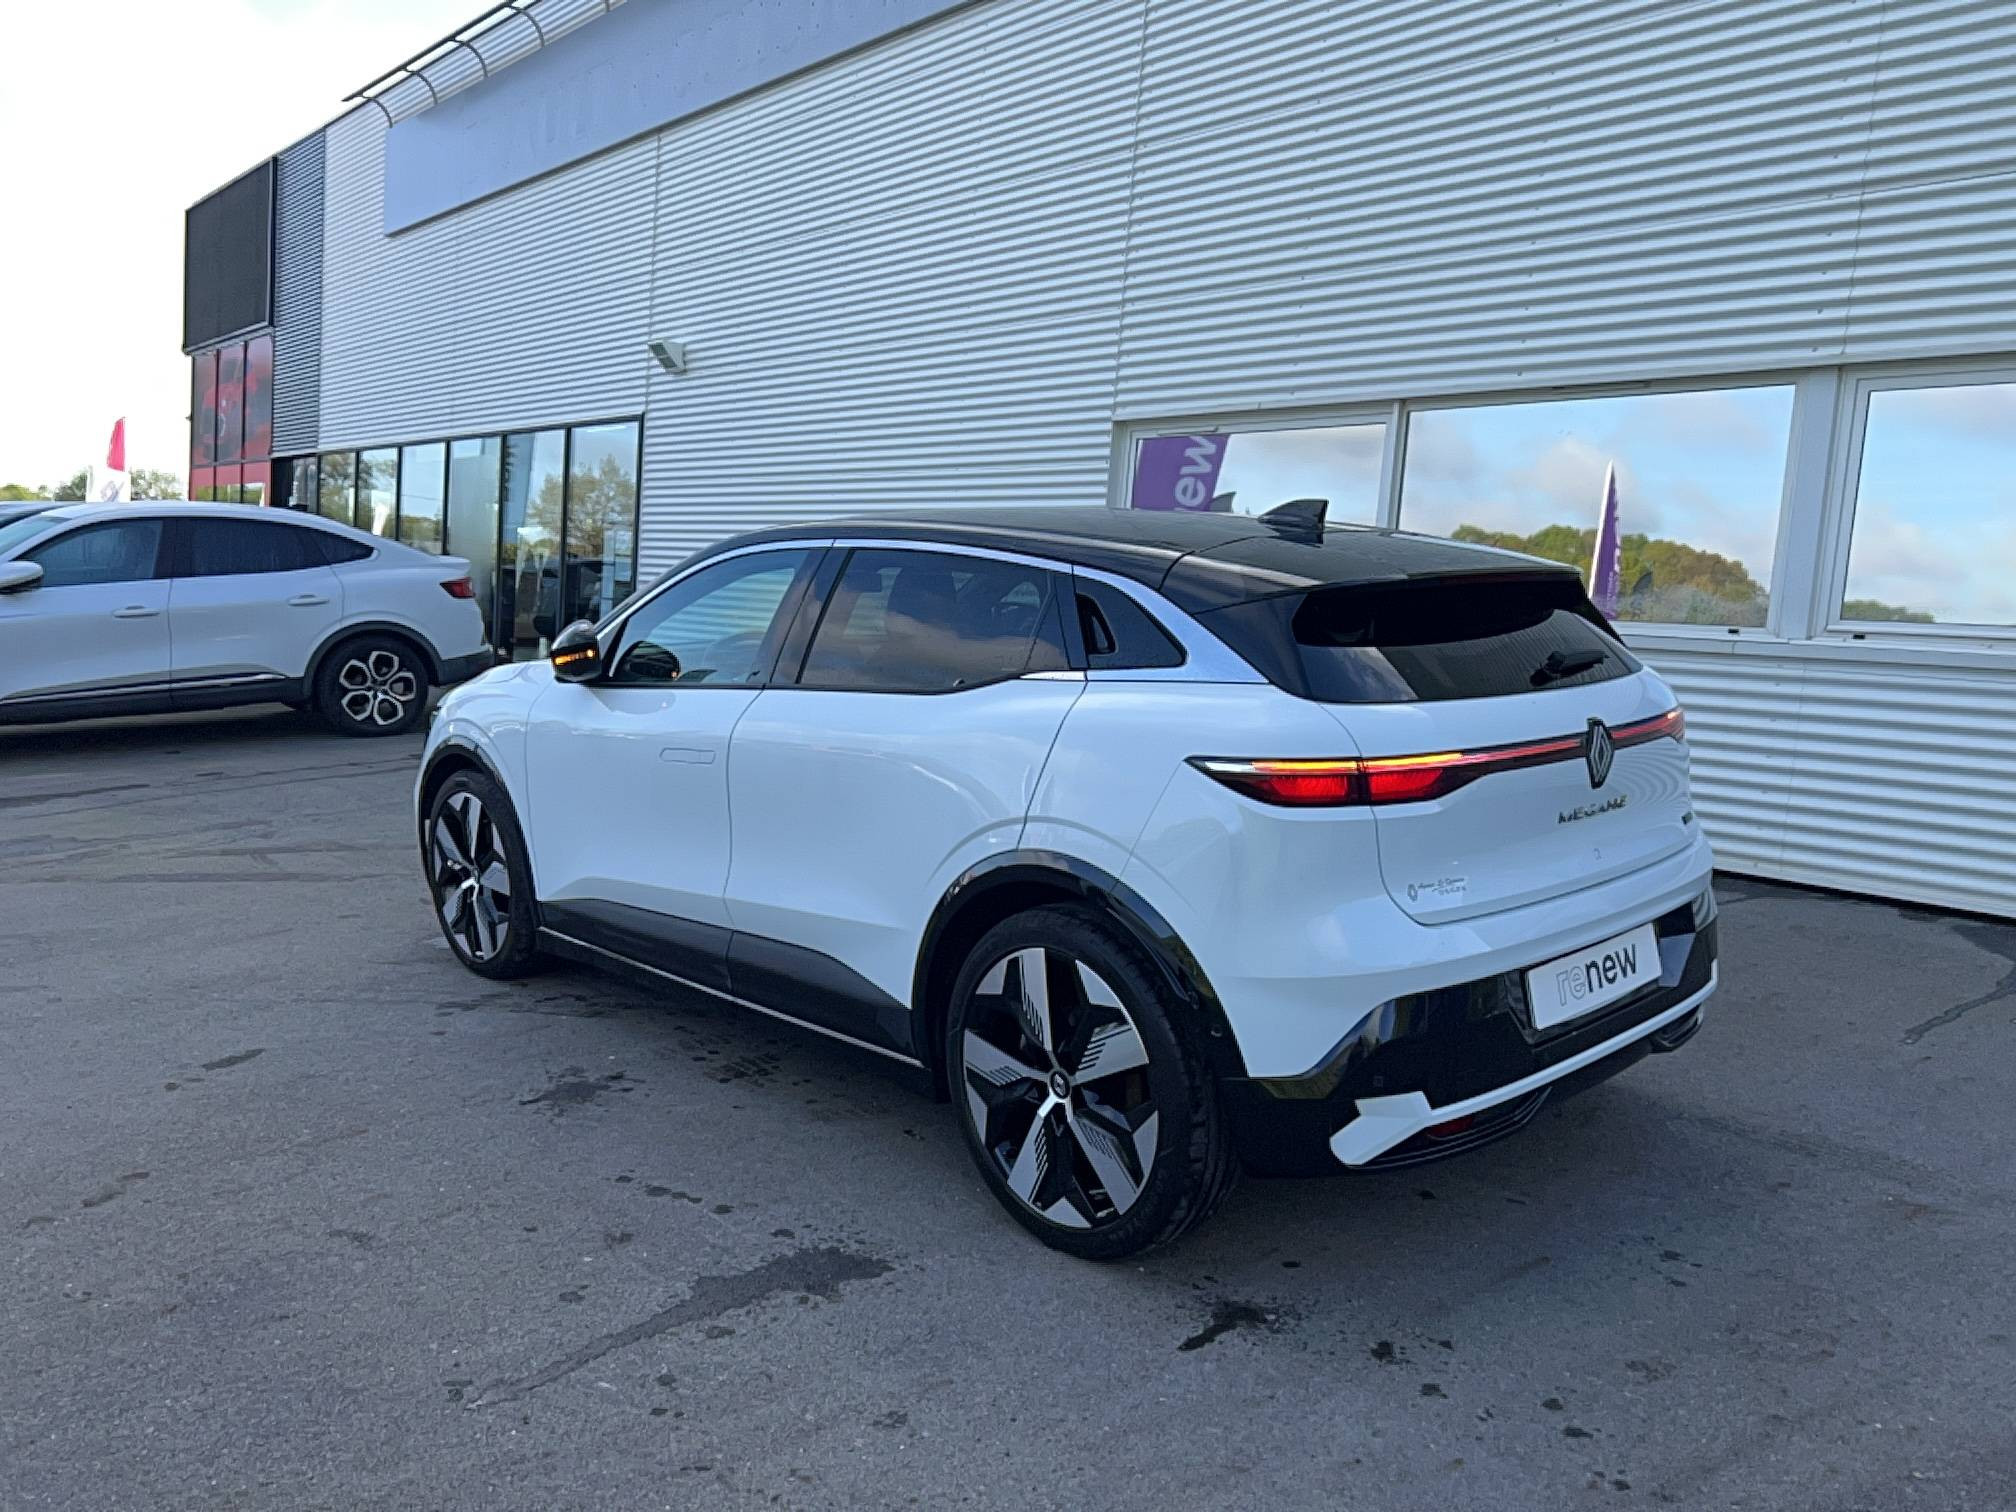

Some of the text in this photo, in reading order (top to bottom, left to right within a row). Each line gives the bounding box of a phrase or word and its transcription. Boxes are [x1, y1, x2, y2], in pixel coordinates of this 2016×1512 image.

[1174, 436, 1216, 511] ew
[1559, 795, 1627, 824] MEGANE
[1556, 944, 1636, 1006] renew
